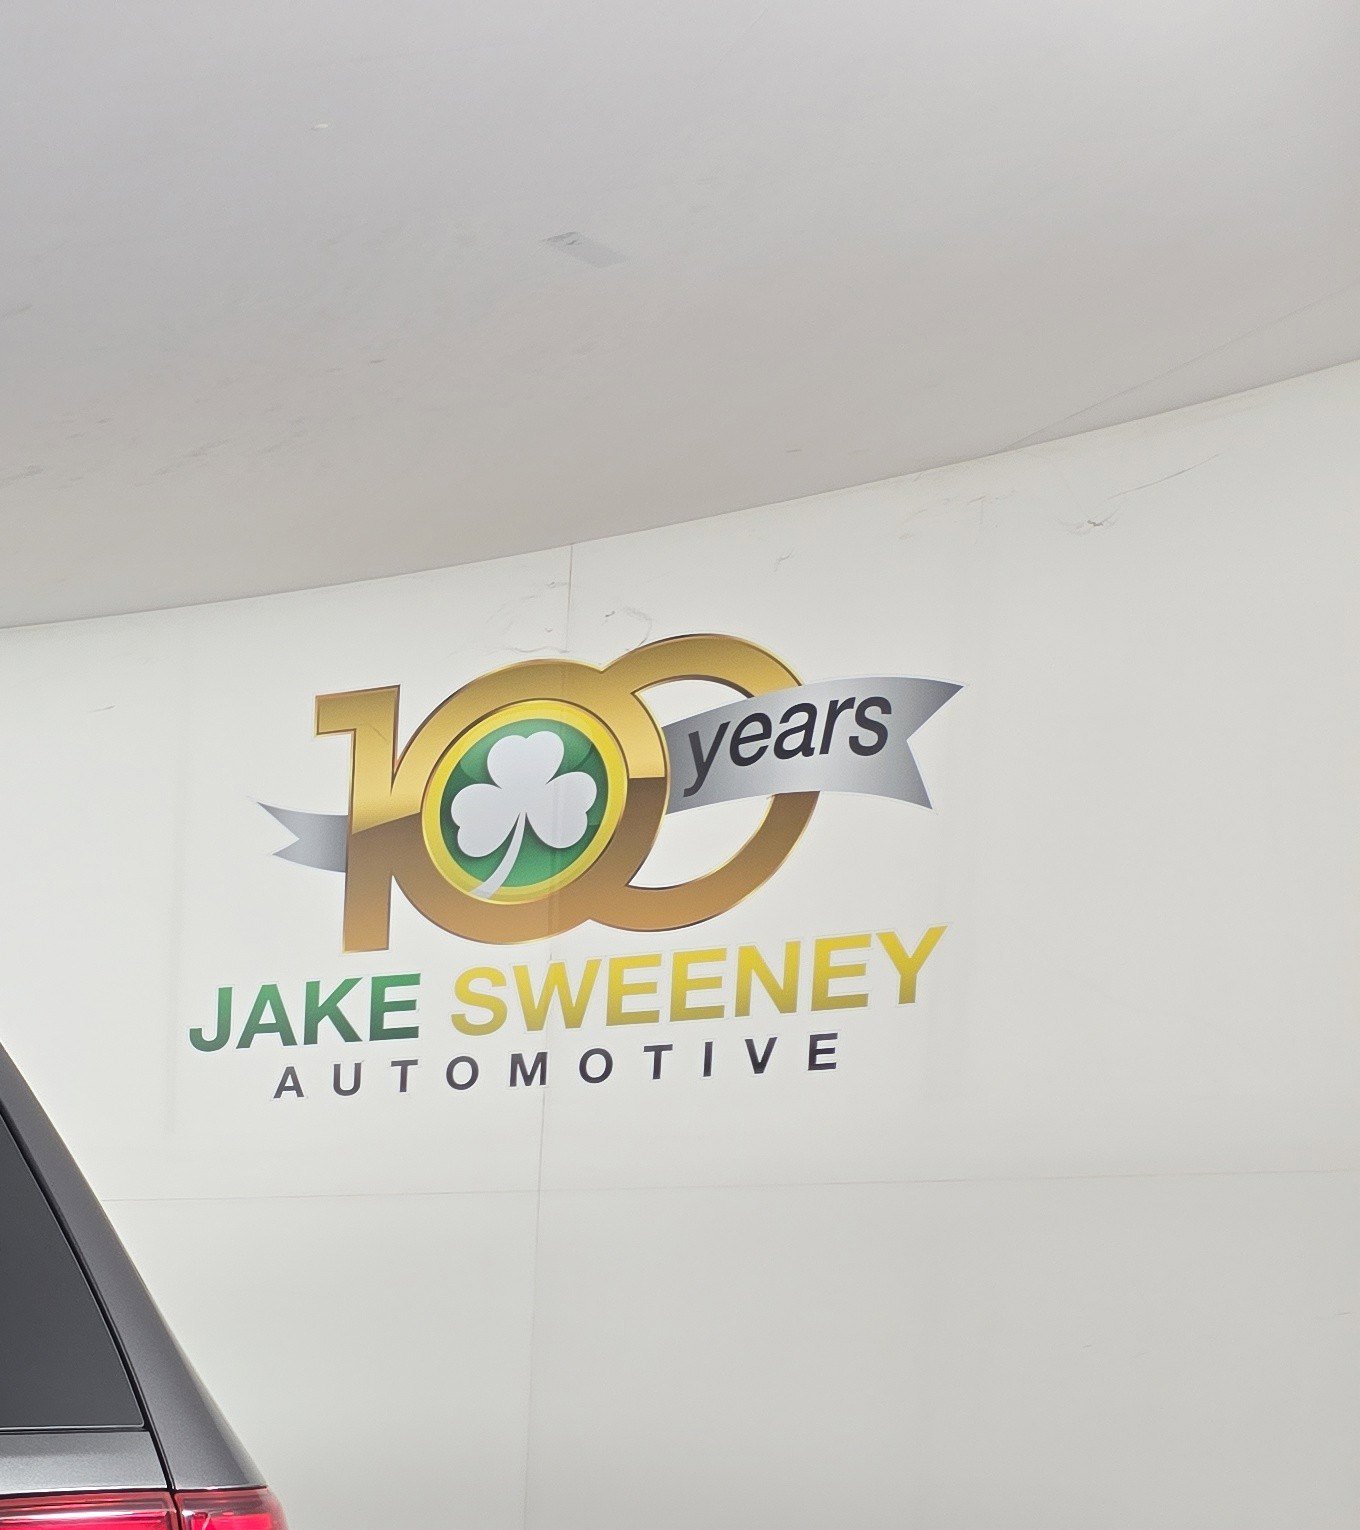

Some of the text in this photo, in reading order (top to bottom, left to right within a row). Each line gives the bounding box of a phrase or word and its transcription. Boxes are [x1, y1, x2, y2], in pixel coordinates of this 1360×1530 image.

[683, 692, 892, 797] years
[189, 926, 948, 1053] JAKE SWEENEY
[273, 1032, 839, 1099] AUTOMOTIVE
